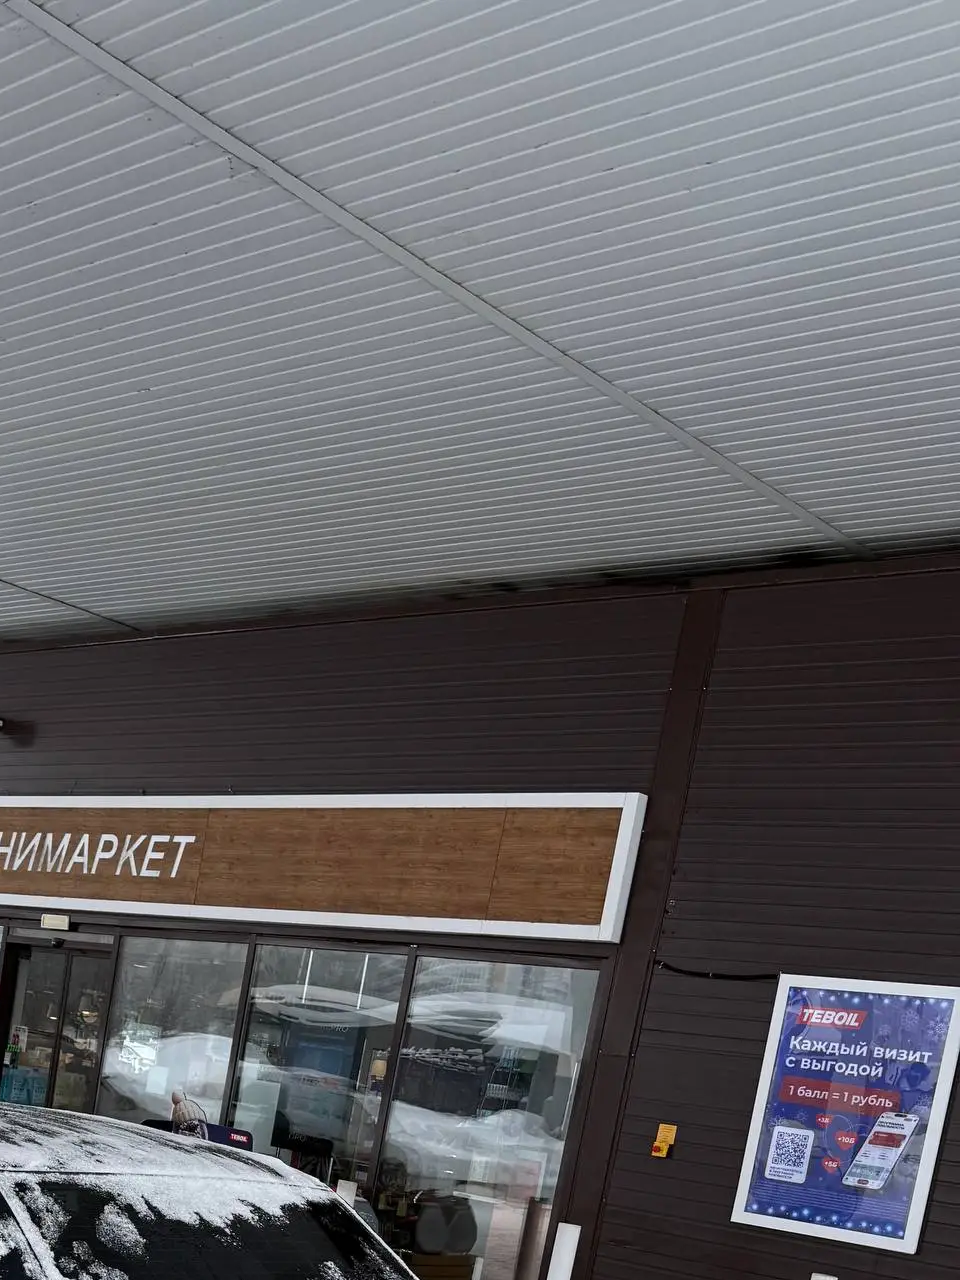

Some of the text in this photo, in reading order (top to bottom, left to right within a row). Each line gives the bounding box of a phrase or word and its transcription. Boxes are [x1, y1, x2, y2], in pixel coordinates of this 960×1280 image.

[802, 1009, 860, 1027] TEBOIL
[789, 1035, 933, 1064] Каждый визит
[800, 1057, 884, 1078] выгодой
[789, 1085, 795, 1096] 1
[797, 1085, 828, 1100] балл
[843, 1092, 848, 1102] 1
[851, 1093, 893, 1108] рубль
